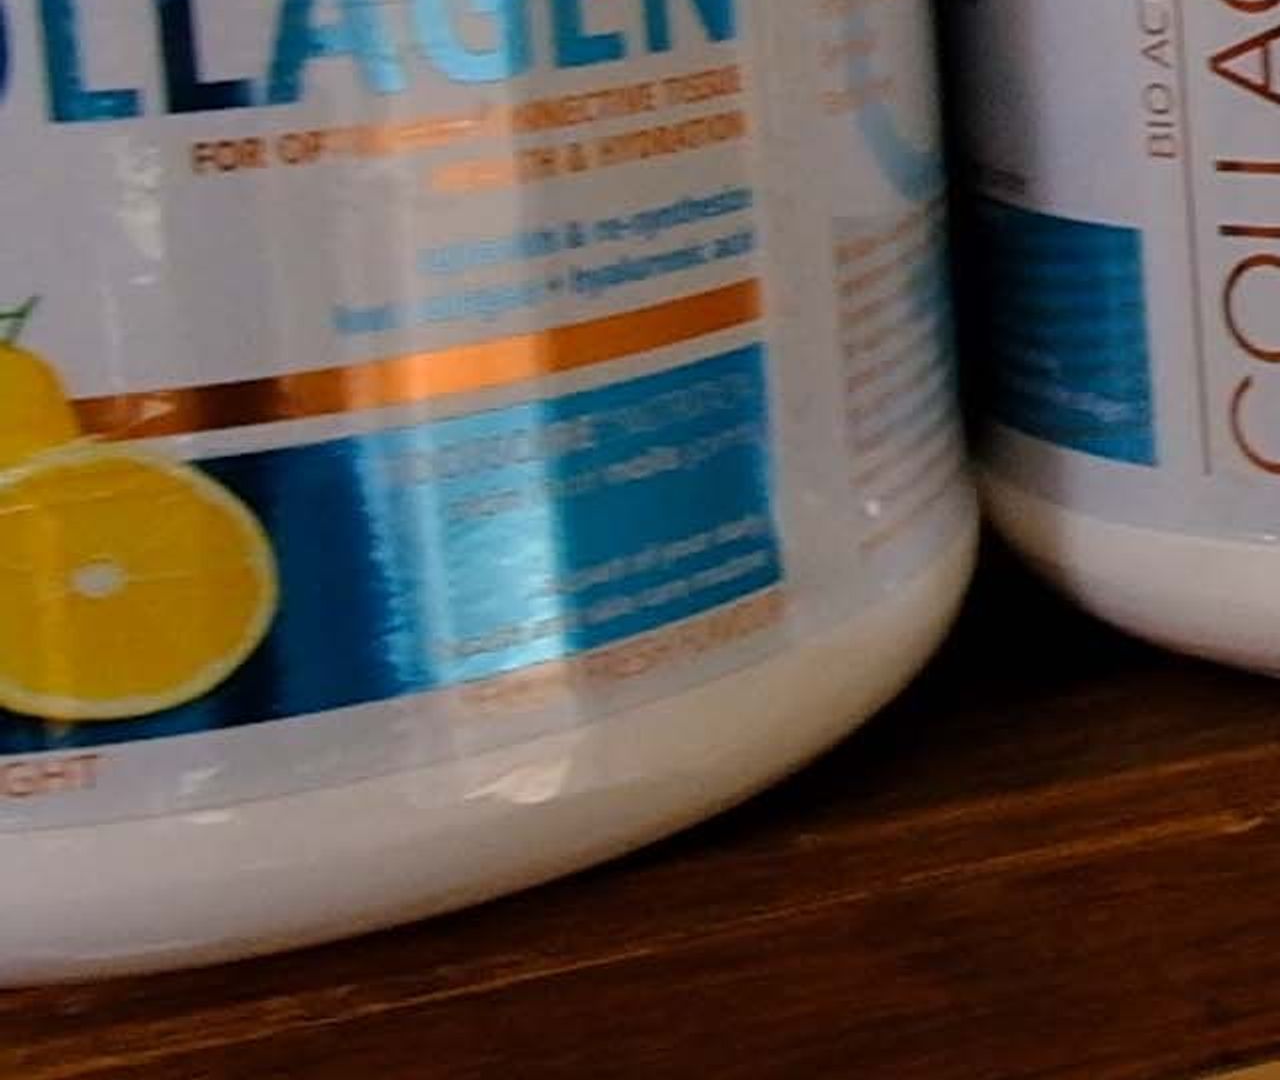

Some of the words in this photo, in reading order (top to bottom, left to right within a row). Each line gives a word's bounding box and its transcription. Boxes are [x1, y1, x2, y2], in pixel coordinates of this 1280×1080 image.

[1146, 80, 1178, 161] BIO
[194, 135, 266, 176] FOR
[0, 752, 99, 799] GHT
